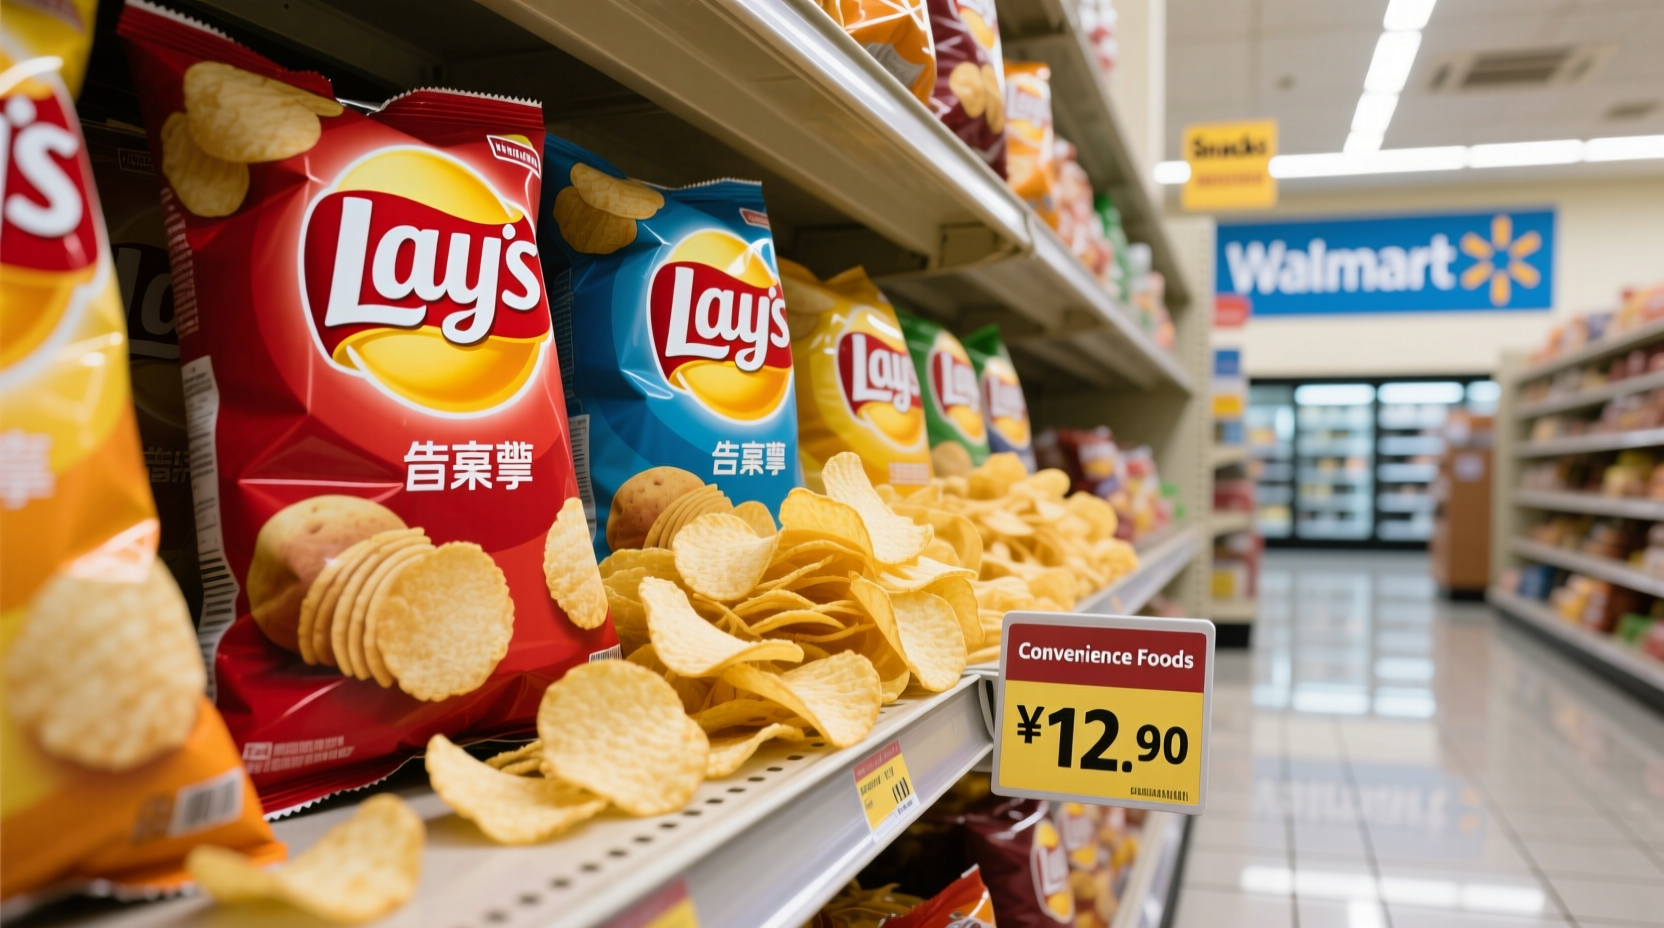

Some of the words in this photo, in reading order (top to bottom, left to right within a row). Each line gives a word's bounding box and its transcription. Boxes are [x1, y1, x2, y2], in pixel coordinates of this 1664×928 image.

[325, 196, 541, 344] Lay's
[1225, 233, 1457, 295] Walmart
[665, 266, 790, 371] Lay's
[1018, 642, 1133, 666] Convenience
[1137, 649, 1195, 669] Foods
